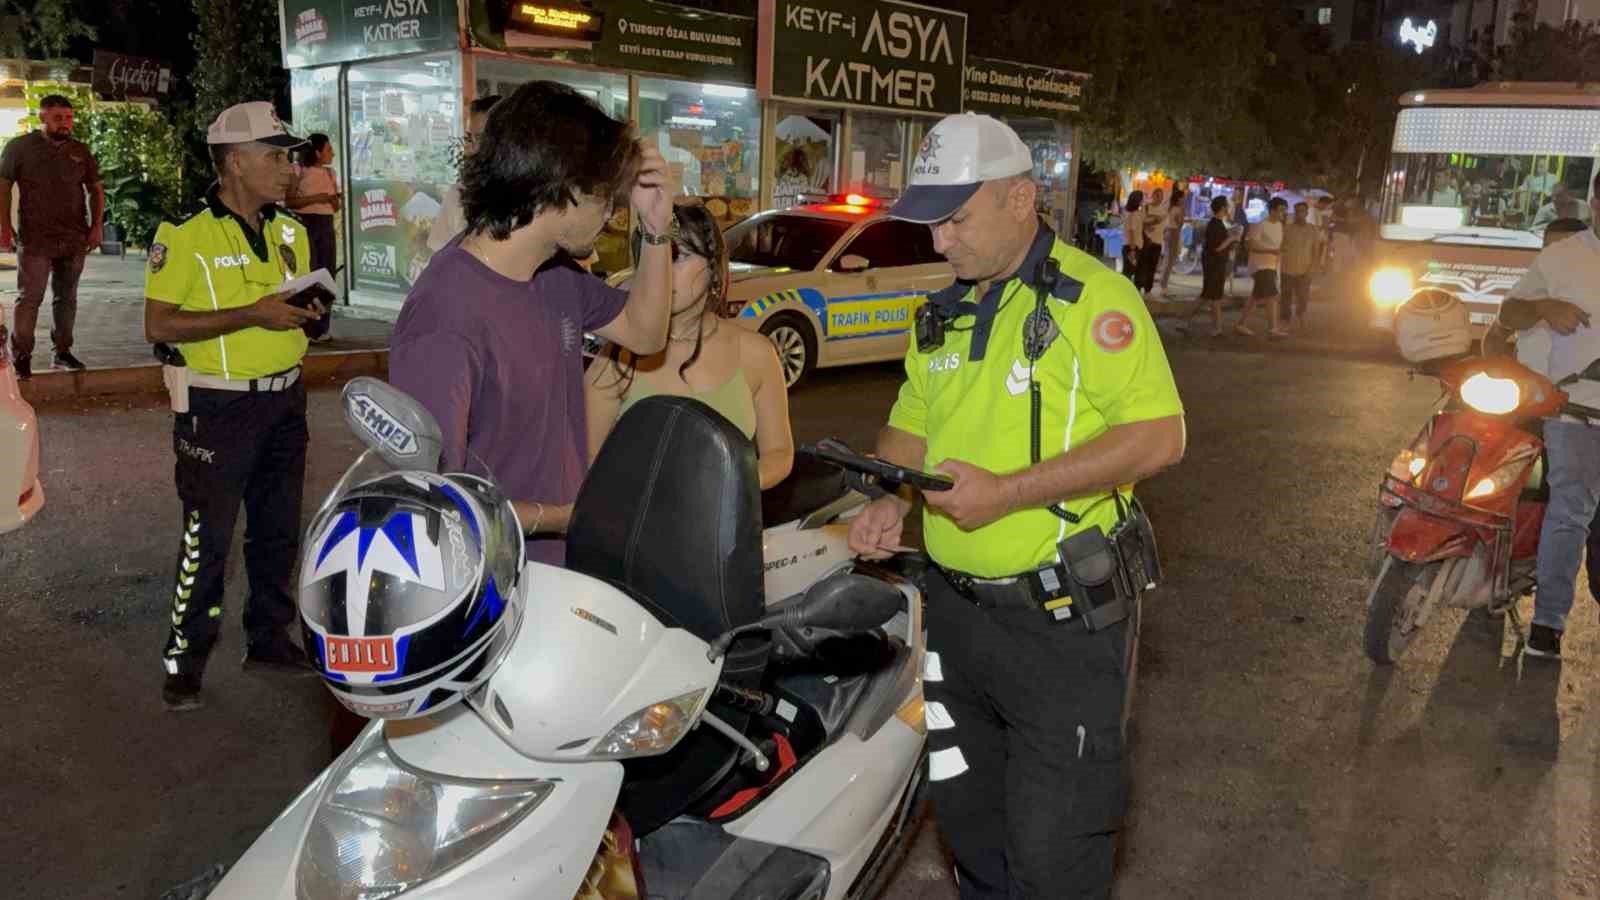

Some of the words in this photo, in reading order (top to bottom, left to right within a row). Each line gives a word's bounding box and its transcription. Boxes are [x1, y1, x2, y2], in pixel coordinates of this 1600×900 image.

[384, 0, 429, 19] ASYA
[363, 20, 420, 44] KATMER
[629, 22, 664, 36] TURGUT
[666, 25, 688, 39] ÖZAL
[690, 32, 742, 47] BULVARINDA
[861, 9, 953, 65] ASYA
[804, 56, 935, 108] KATMER
[964, 66, 988, 83] Yine
[989, 70, 1025, 88] Damak
[360, 251, 393, 267] ASYA
[356, 400, 411, 449] SHOEI
